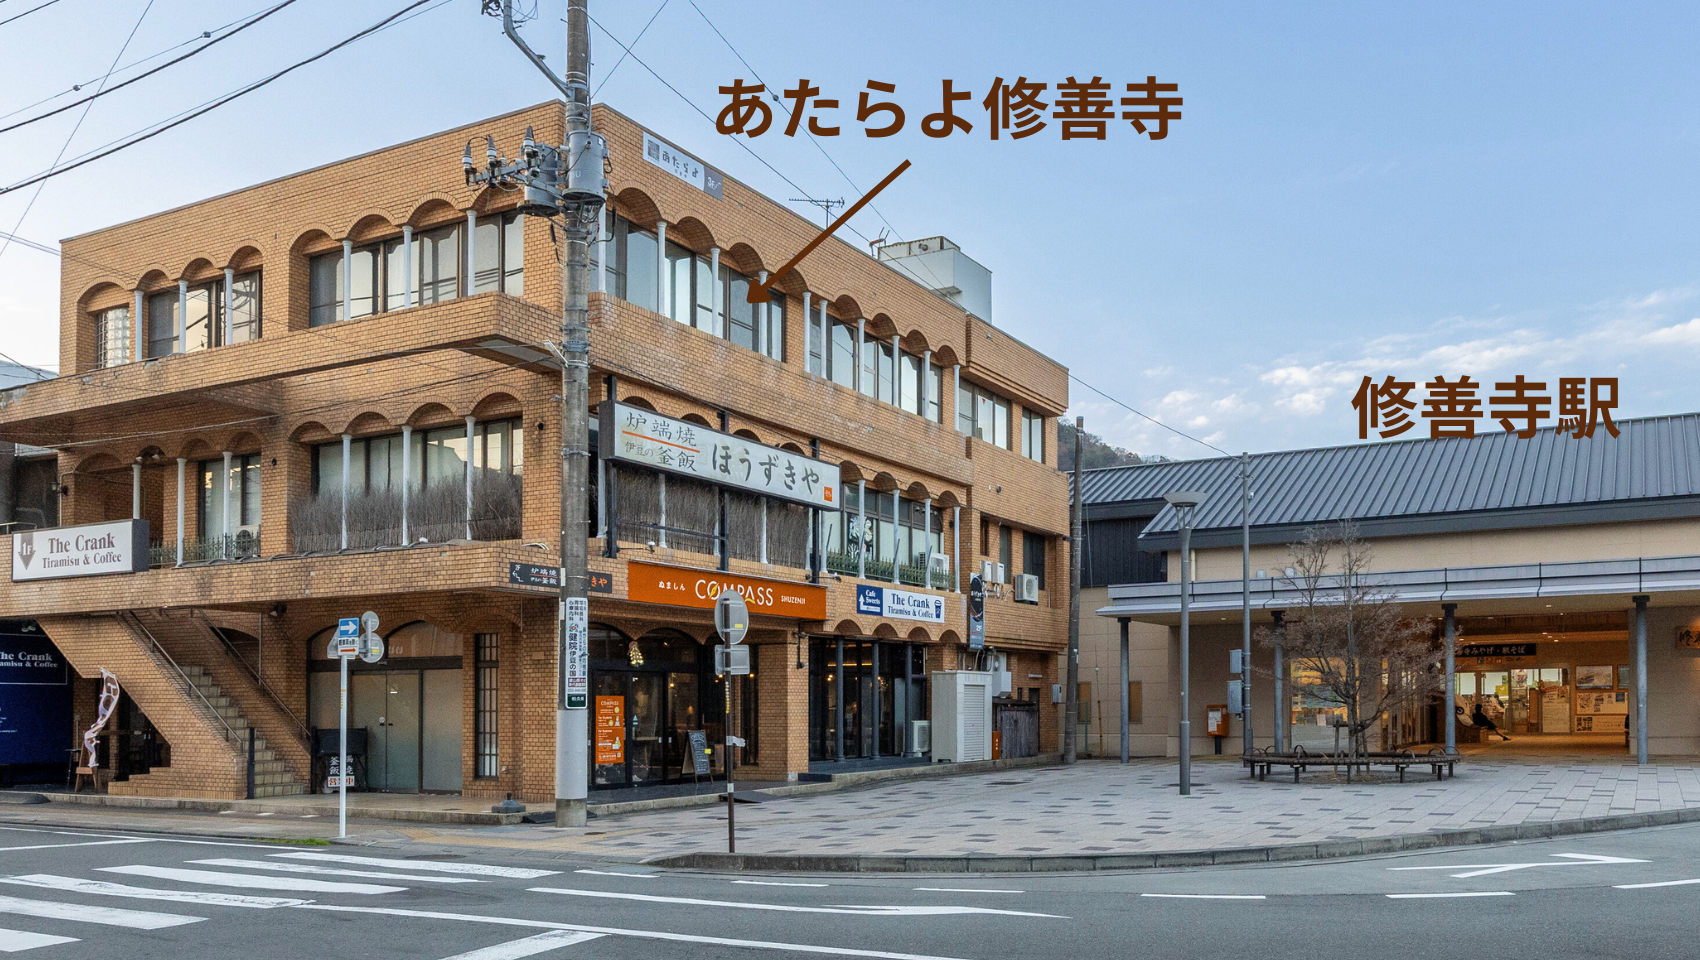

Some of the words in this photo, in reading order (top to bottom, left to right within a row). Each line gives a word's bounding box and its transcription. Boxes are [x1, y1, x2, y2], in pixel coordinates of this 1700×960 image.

[662, 150, 699, 178] あたらよ
[626, 412, 697, 447] 炉端焼
[625, 441, 697, 472] 伊豆の釜飯
[712, 443, 820, 495] ほうずきや
[48, 537, 71, 554] The
[75, 532, 115, 552] Crank
[42, 555, 80, 569] Tiramisu
[83, 553, 90, 565] &
[93, 551, 122, 565] Coffee
[587, 575, 608, 588] きや
[658, 580, 686, 592] ぬましん
[695, 579, 774, 606] COMPASS
[781, 595, 806, 605] SHUZENJI
[891, 593, 906, 606] The
[907, 595, 931, 609] Crank
[888, 605, 911, 616] Tiramisu
[912, 608, 917, 617] &
[918, 608, 934, 618] Coffee
[18, 651, 53, 661] Crank
[329, 777, 354, 786] 営中
